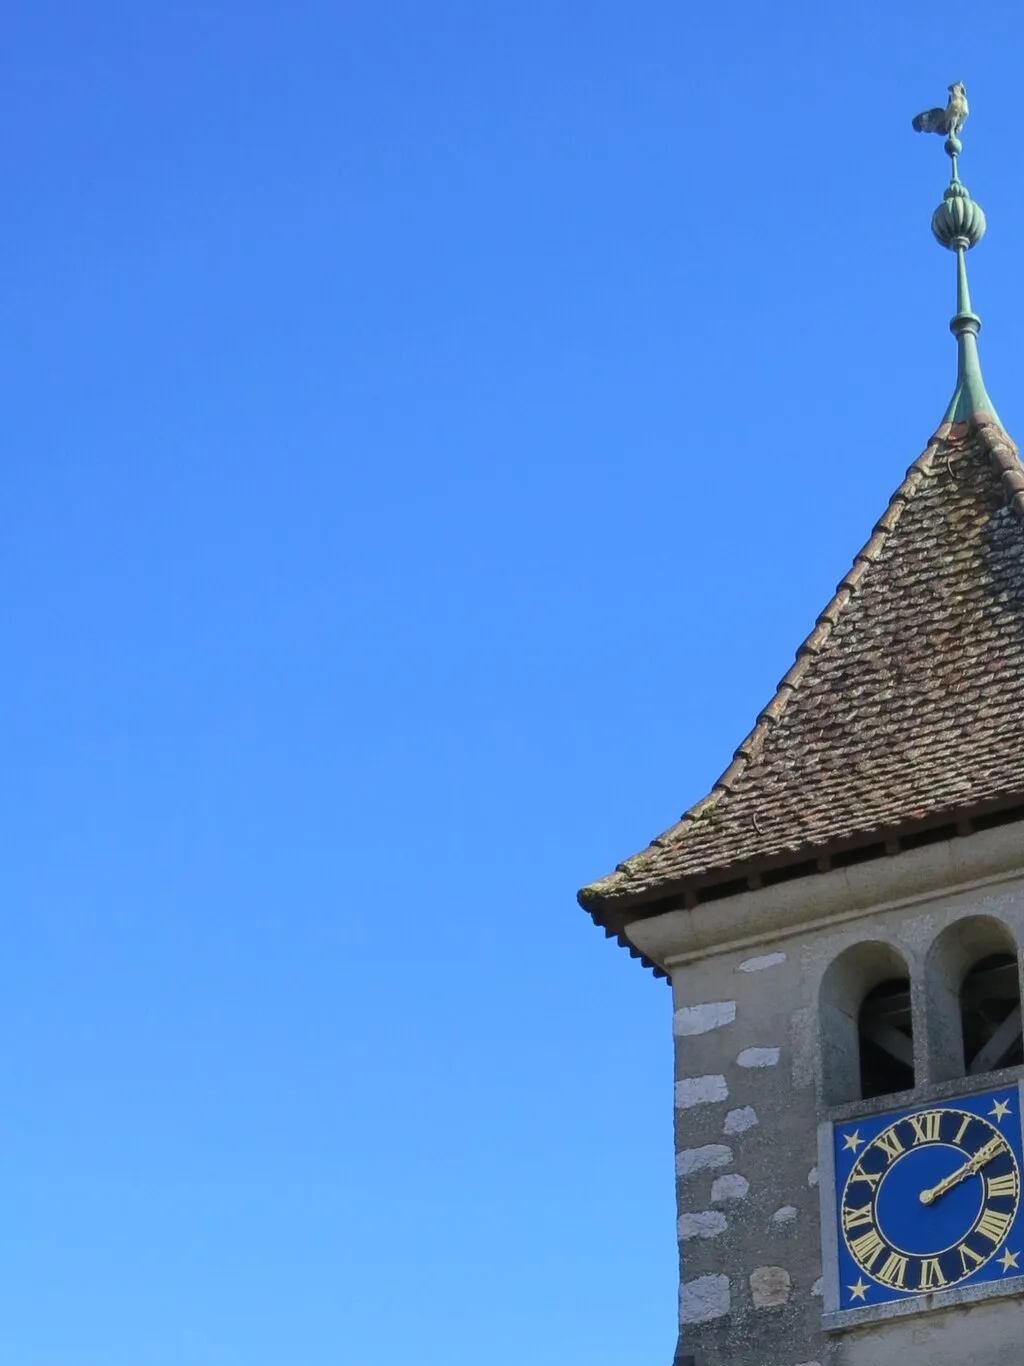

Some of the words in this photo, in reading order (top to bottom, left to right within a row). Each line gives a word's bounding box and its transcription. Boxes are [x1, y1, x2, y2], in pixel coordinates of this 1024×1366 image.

[908, 1113, 943, 1145] XII
[952, 1115, 973, 1144] I
[874, 1127, 906, 1164] XI
[851, 1164, 882, 1192] X
[987, 1170, 1016, 1199] III
[845, 1201, 873, 1230] IX
[974, 1208, 1012, 1244] IIII
[850, 1227, 886, 1270] VIII
[958, 1243, 985, 1274] V
[876, 1251, 909, 1286] VII
[918, 1257, 947, 1288] VI
